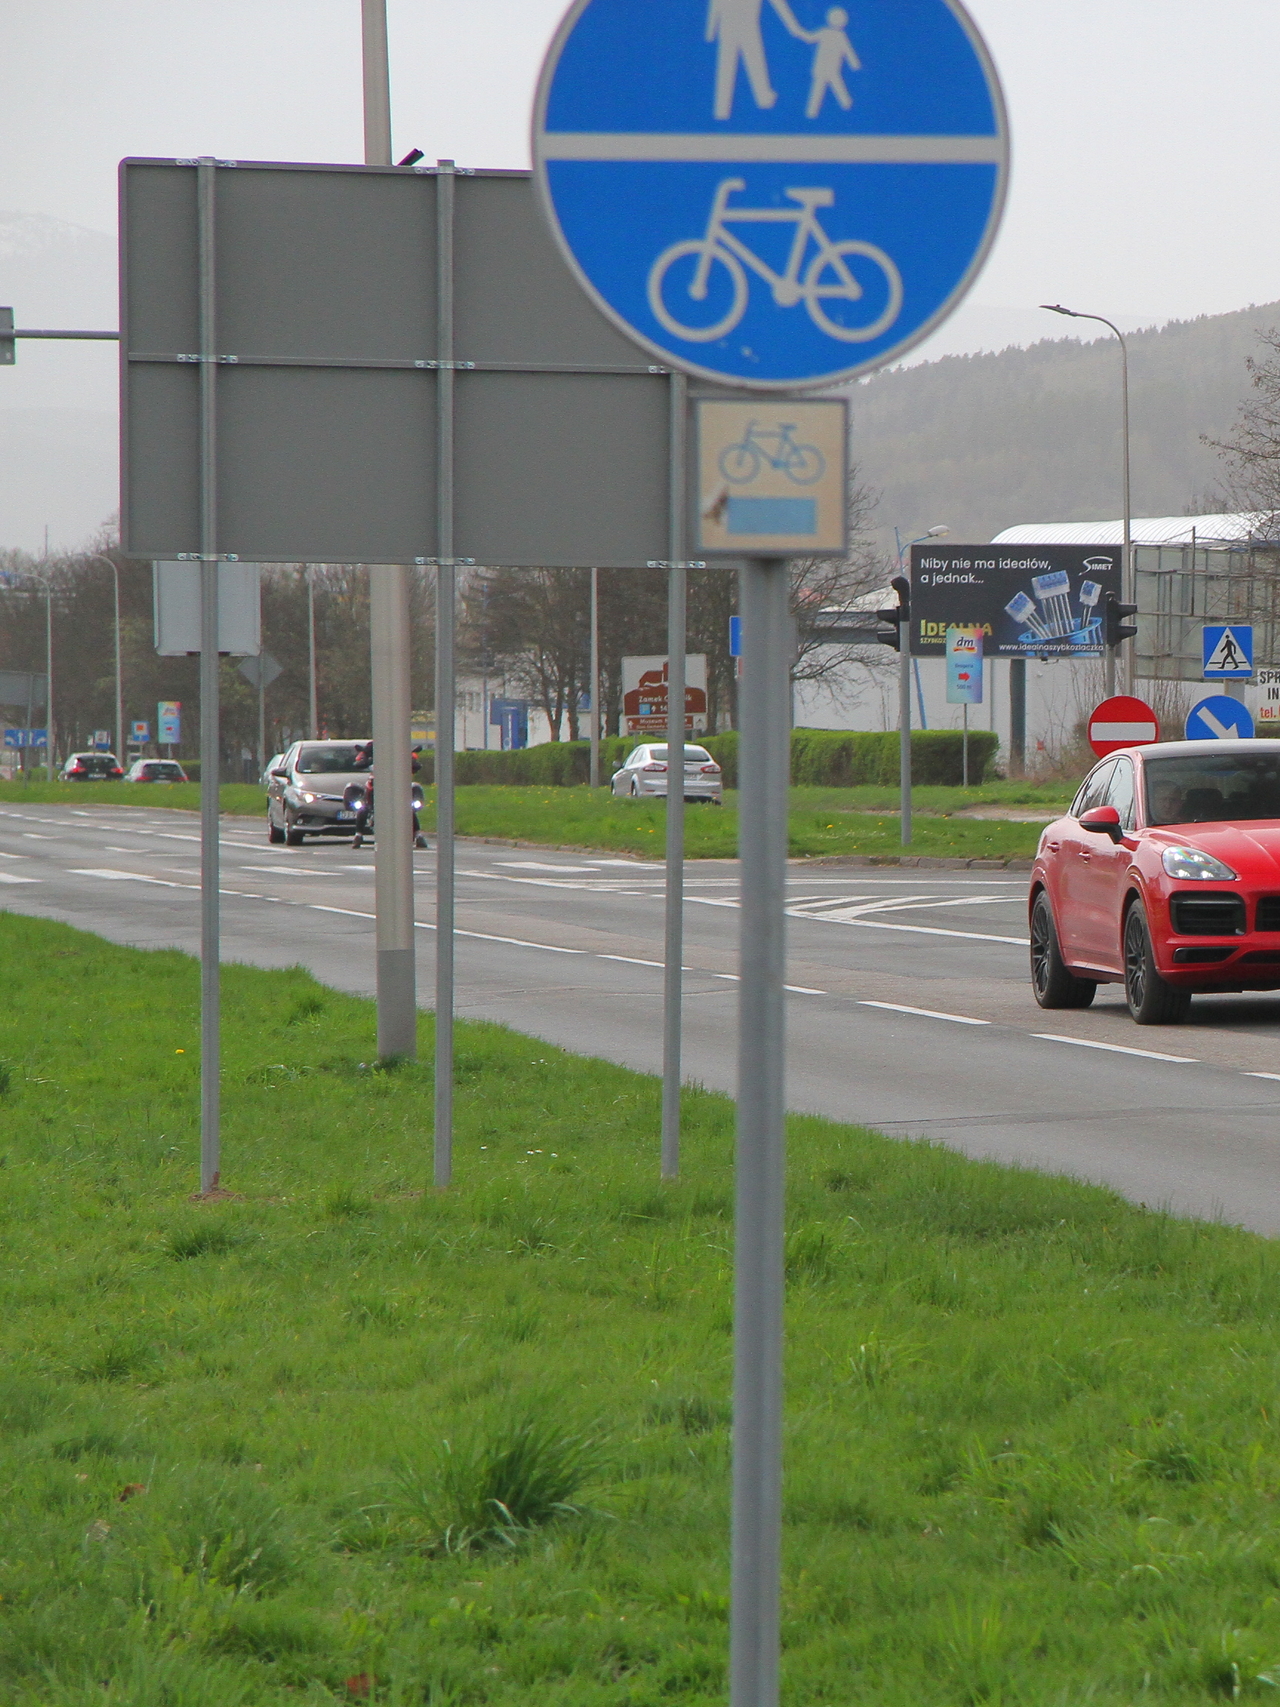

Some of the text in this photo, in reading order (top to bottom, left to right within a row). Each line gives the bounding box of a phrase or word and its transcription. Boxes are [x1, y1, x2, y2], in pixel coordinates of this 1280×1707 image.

[920, 557, 1051, 571] Niby nie ma ideałów,
[1078, 555, 1113, 576] SIMET
[920, 572, 984, 587] a jednak...
[956, 636, 974, 647] dm
[1260, 706, 1276, 718] tel.
